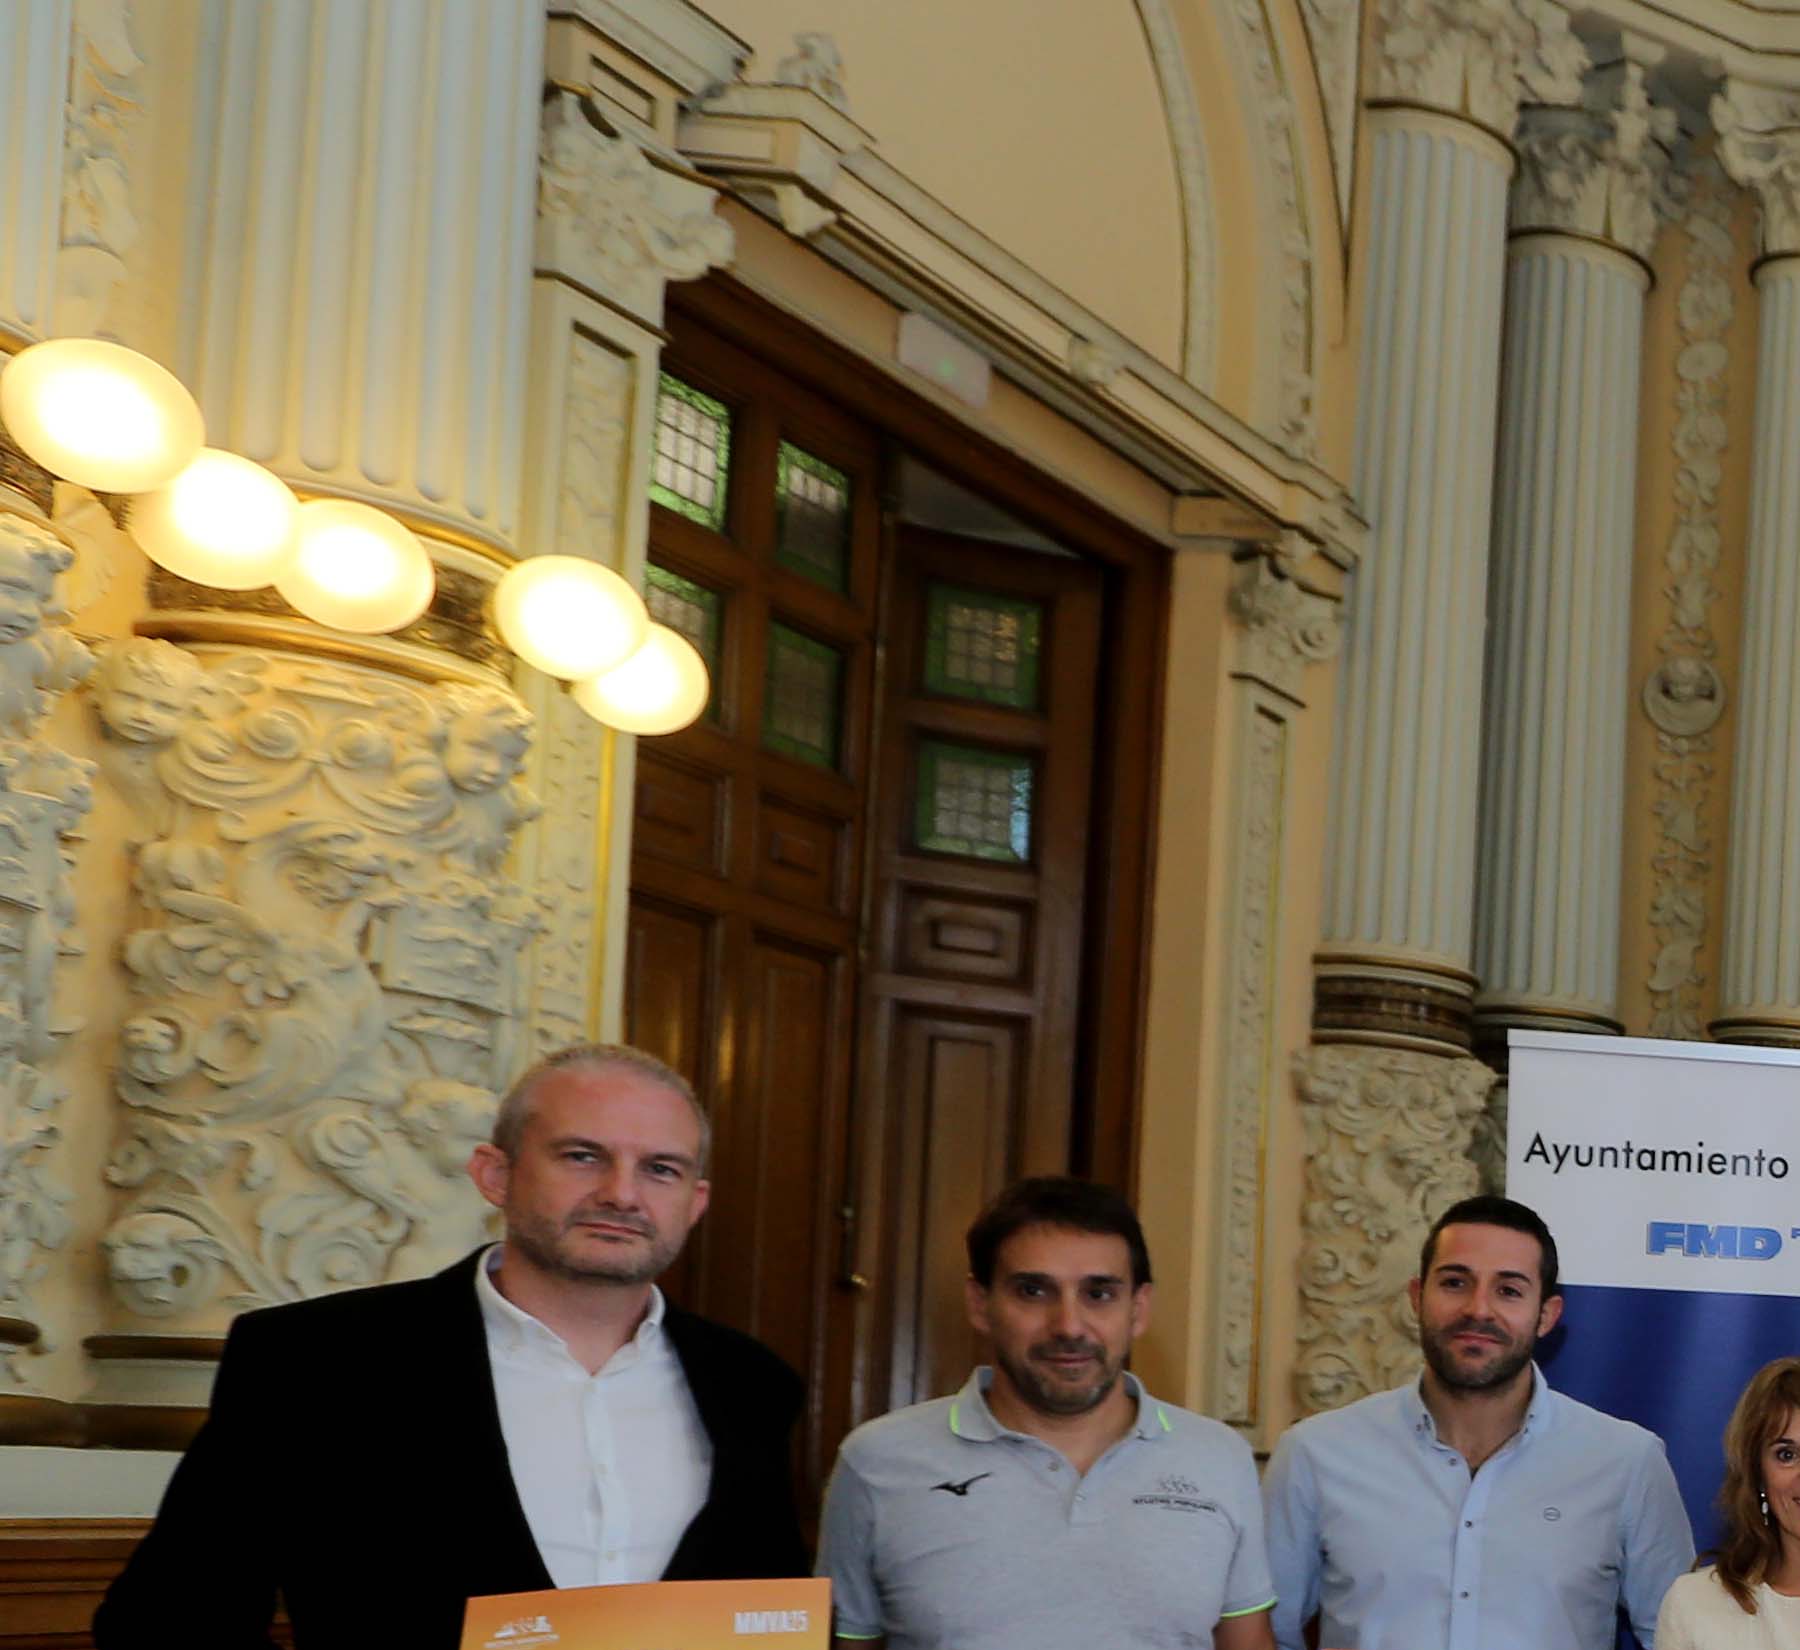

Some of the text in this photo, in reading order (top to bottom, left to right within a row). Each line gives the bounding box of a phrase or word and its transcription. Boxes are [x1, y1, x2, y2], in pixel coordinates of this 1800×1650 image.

[1524, 1132, 1789, 1181] Ayuntamiento
[1646, 1221, 1782, 1261] FMD
[734, 1611, 808, 1634] MMVA25
